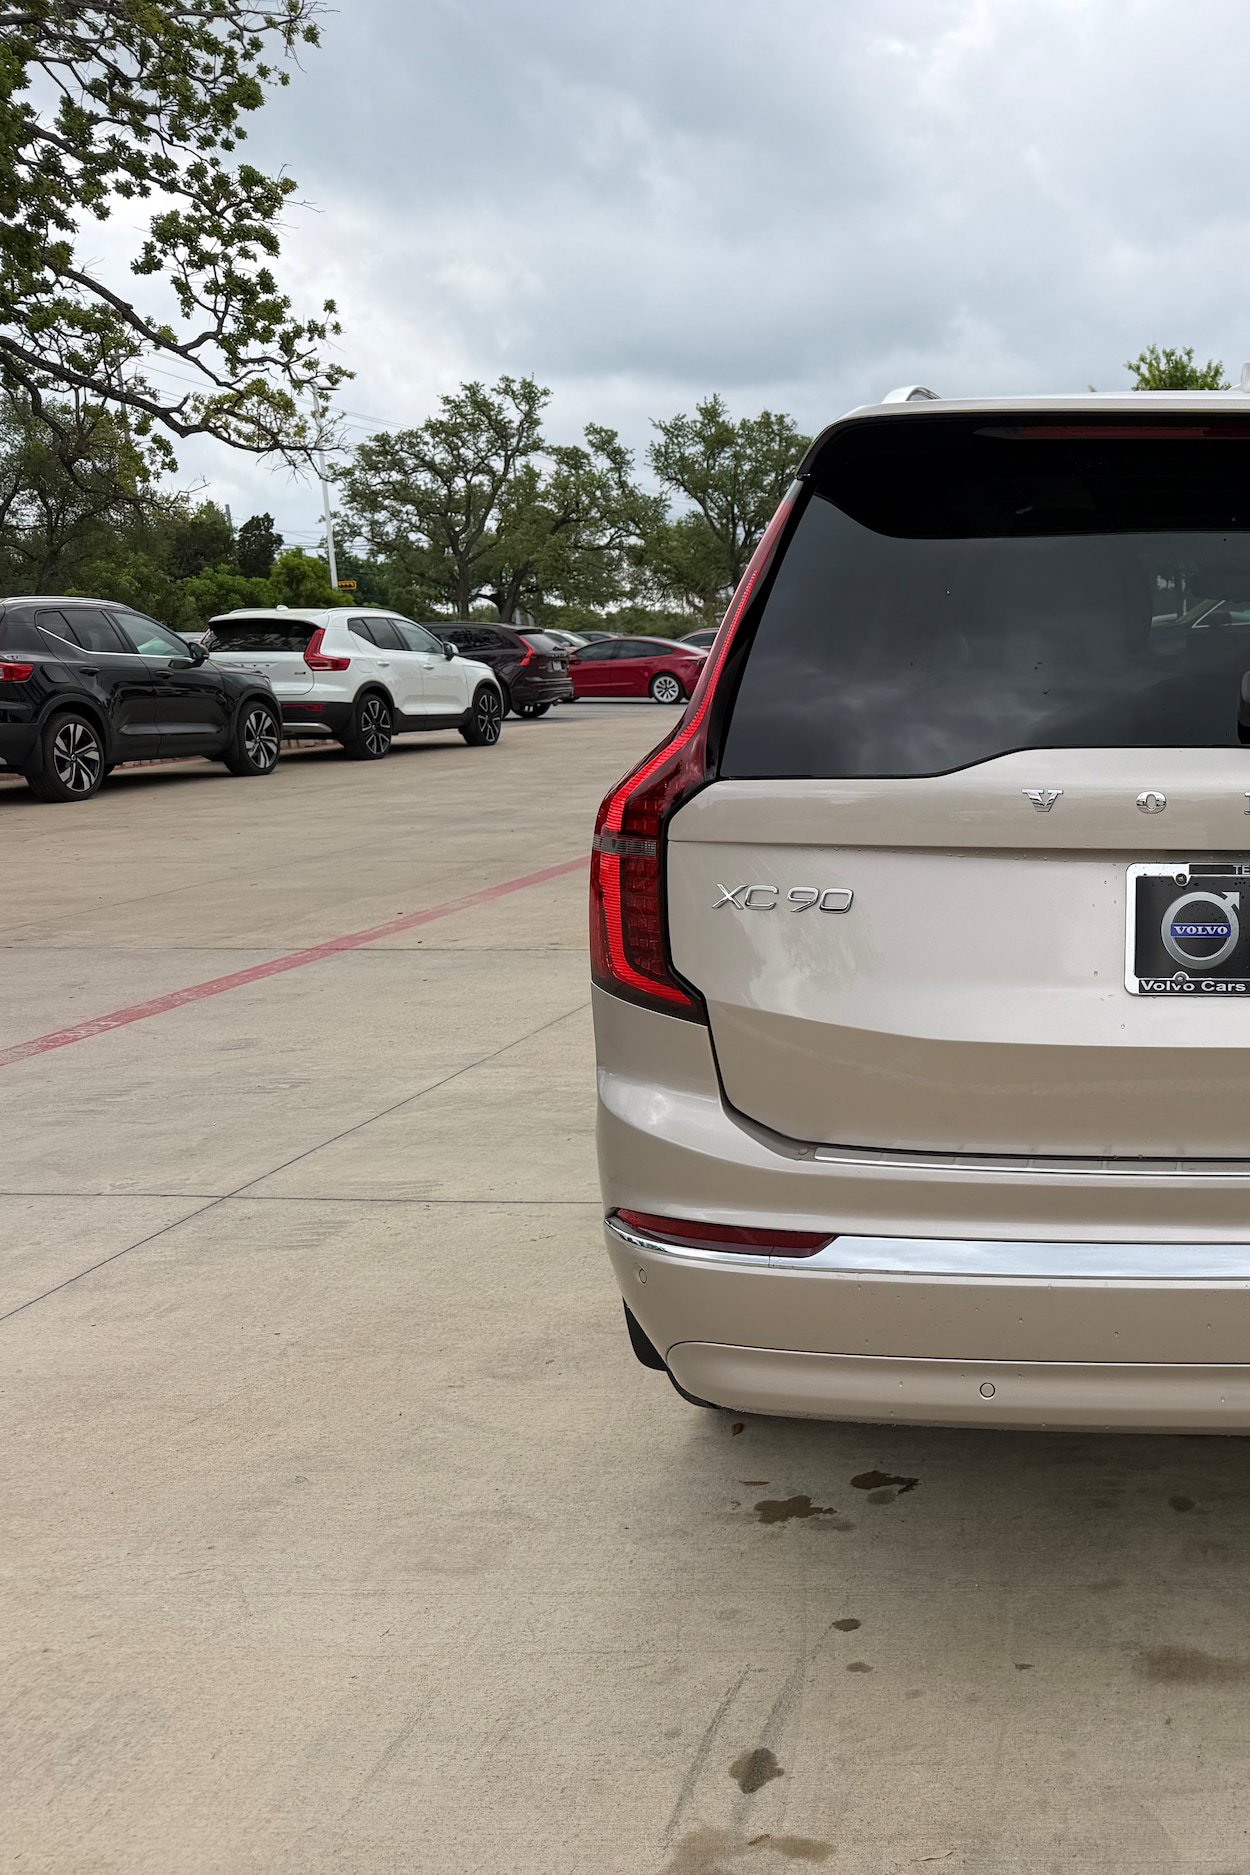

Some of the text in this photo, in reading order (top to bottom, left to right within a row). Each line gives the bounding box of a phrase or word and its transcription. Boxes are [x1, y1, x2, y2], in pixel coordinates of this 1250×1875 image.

[1173, 925, 1228, 936] VOLVO
[1140, 980, 1195, 991] Volvo
[1201, 981, 1246, 992] Cars
